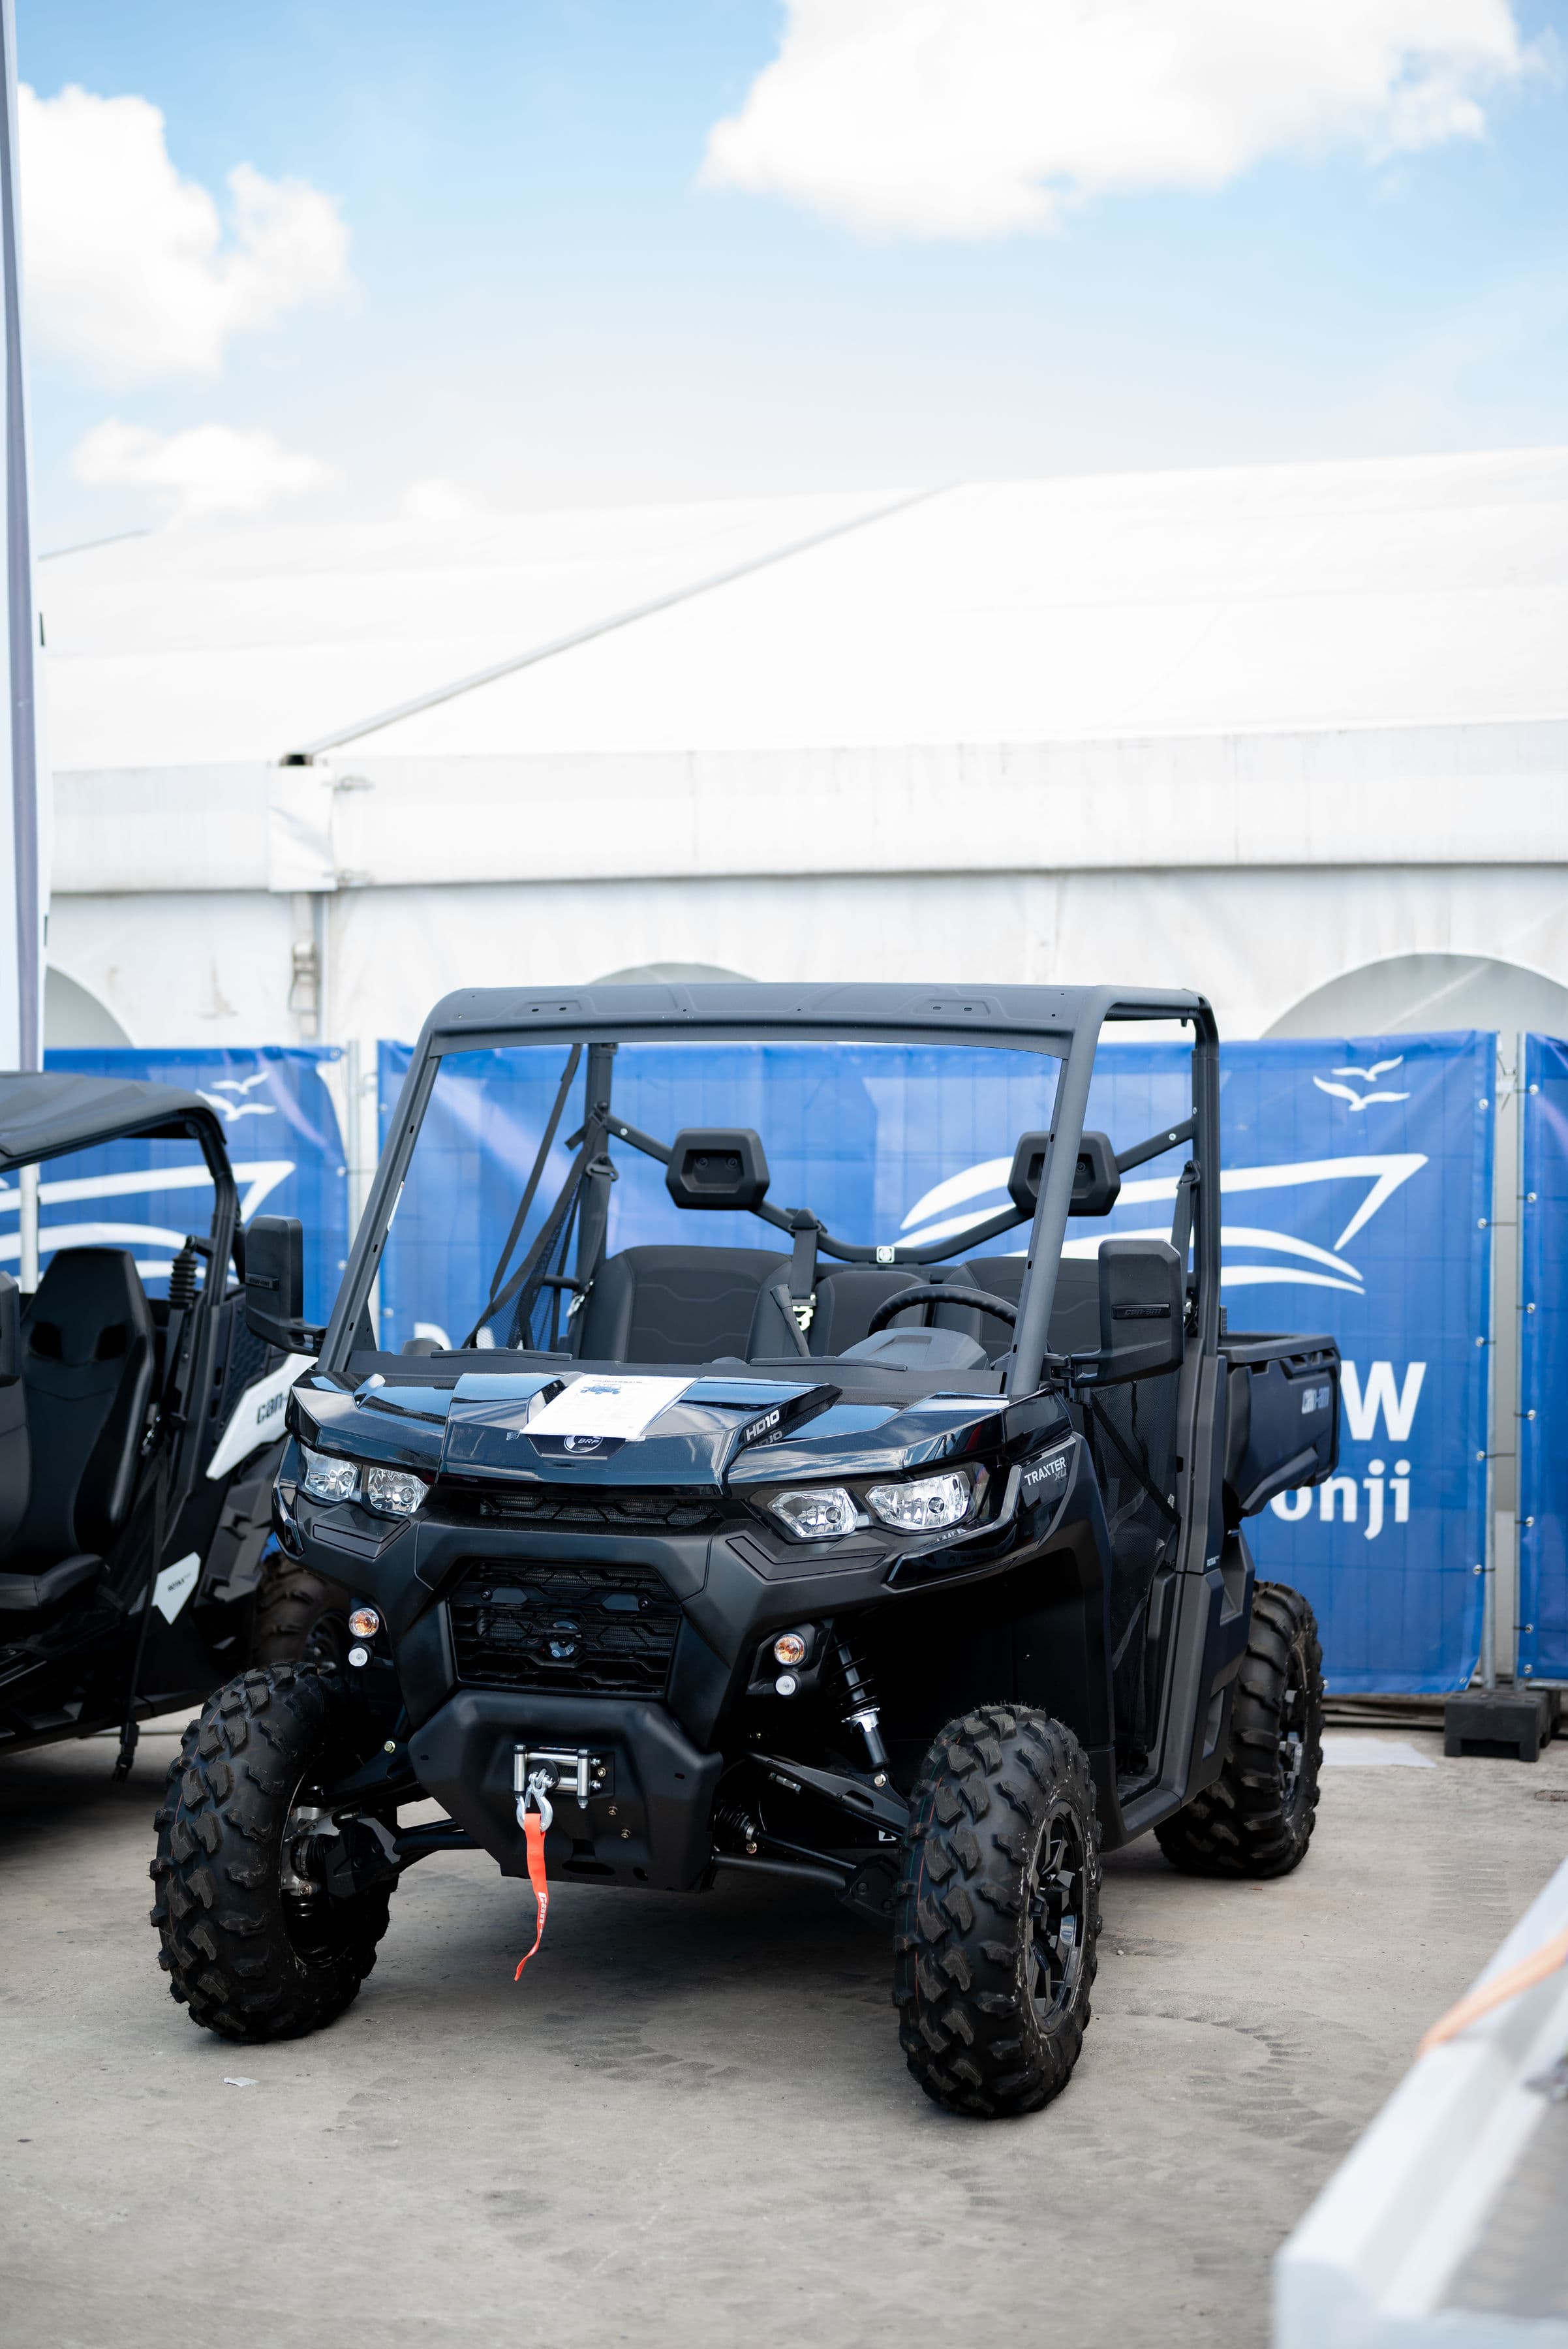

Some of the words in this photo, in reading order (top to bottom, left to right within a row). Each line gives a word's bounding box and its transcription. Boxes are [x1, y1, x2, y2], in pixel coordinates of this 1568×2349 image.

[257, 1392, 288, 1424] can-
[746, 1409, 780, 1441] HD10
[1024, 1456, 1066, 1486] TRAXTER
[1270, 1459, 1411, 1540] onji
[538, 1892, 547, 1939] can-
